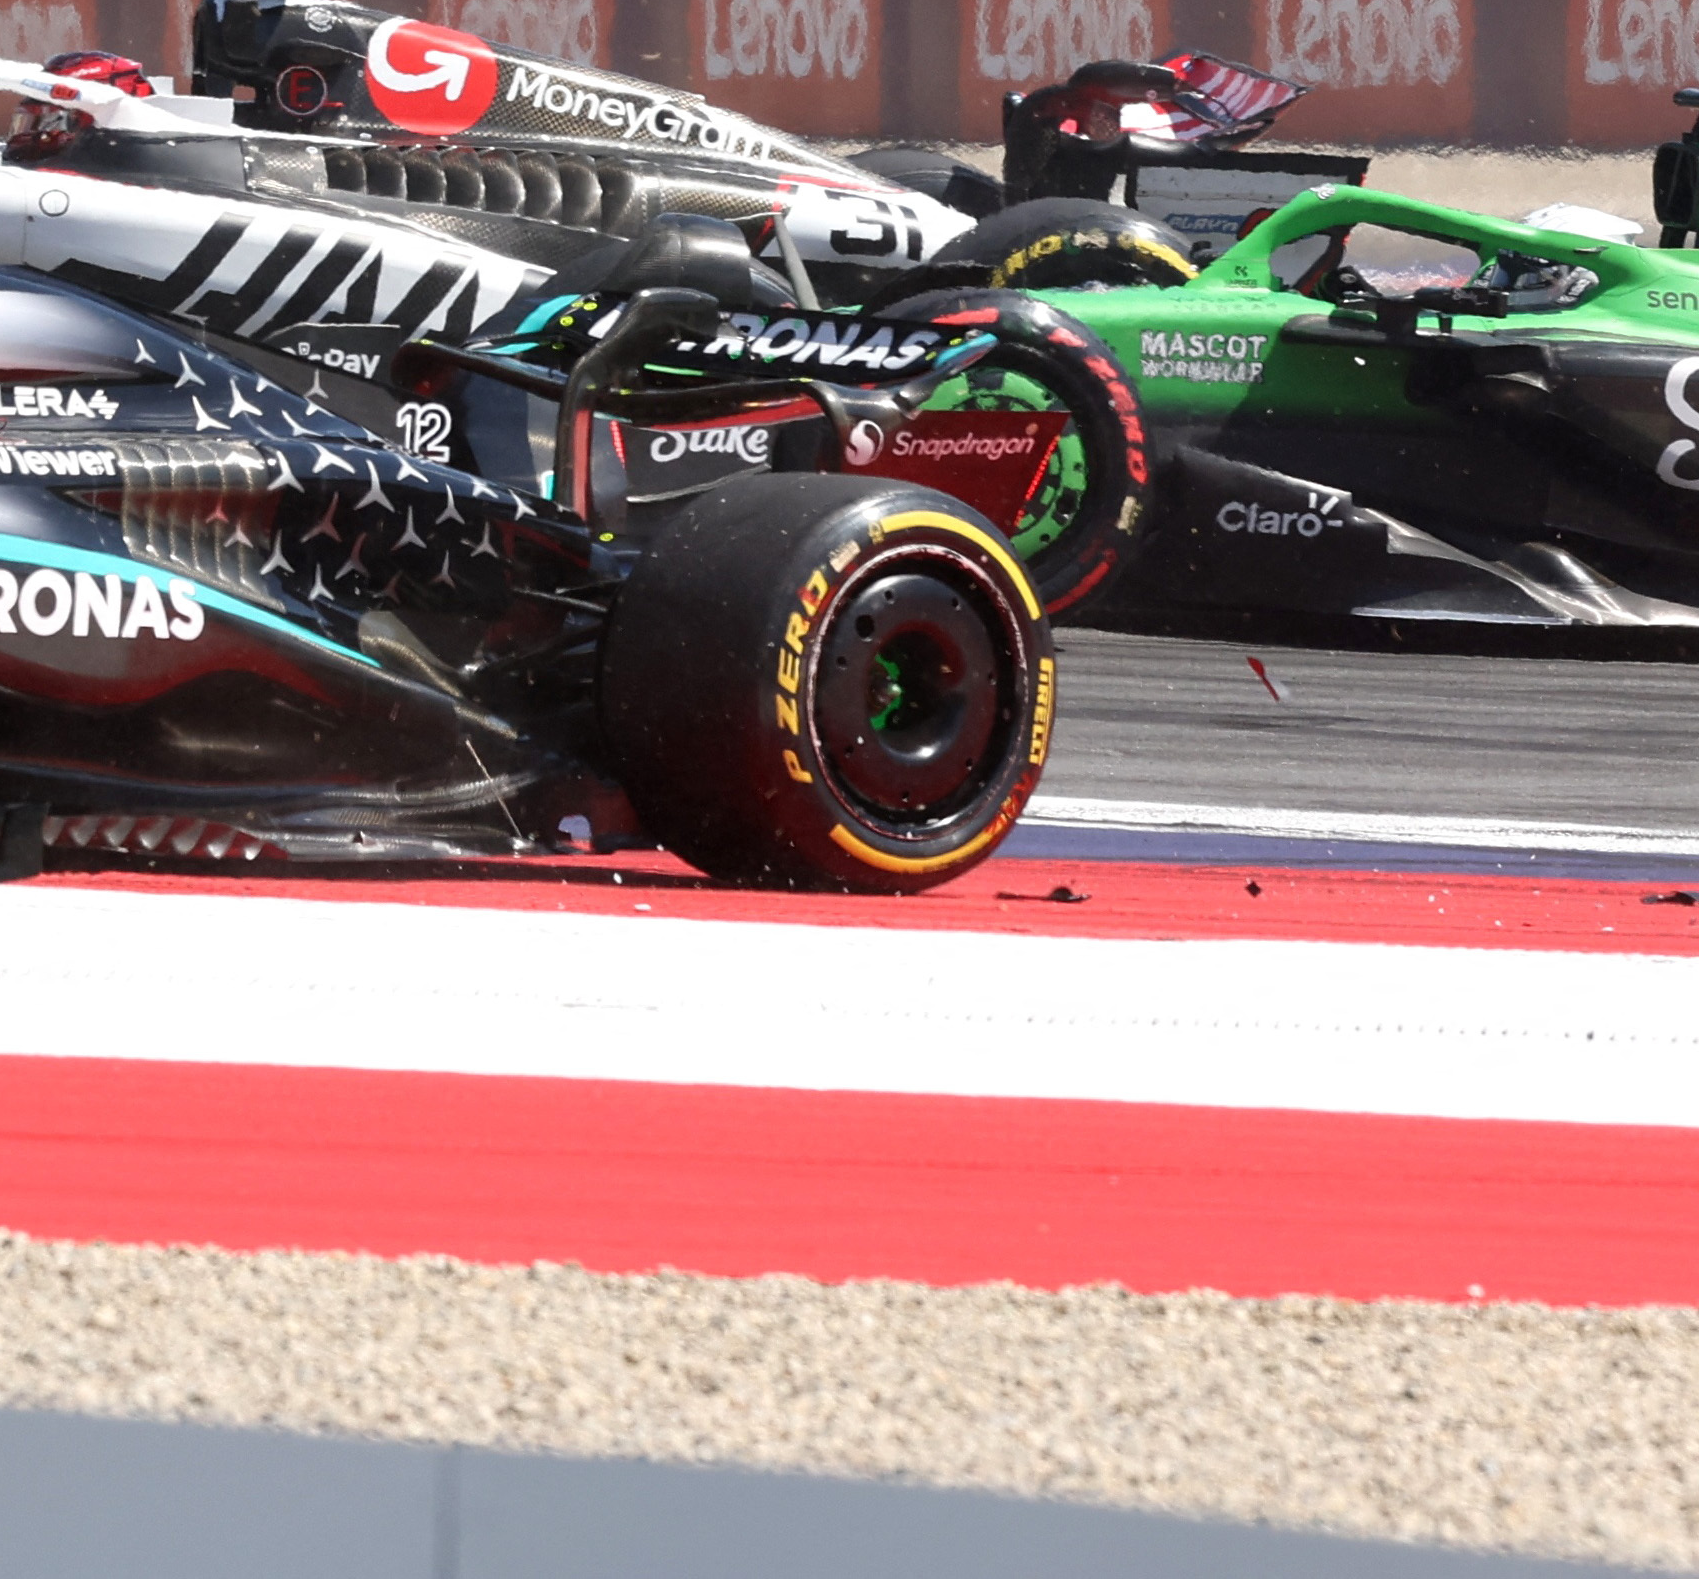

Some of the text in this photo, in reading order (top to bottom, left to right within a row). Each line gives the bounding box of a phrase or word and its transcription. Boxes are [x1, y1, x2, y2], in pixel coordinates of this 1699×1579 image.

[507, 65, 773, 162] MoneyGram
[827, 188, 923, 263] 31
[1140, 330, 1267, 360] MASCOT
[397, 403, 451, 463] 12
[650, 423, 768, 463] Stake
[891, 430, 1037, 462] Snapdragon
[1216, 500, 1323, 538] Claro
[781, 748, 814, 784] P
